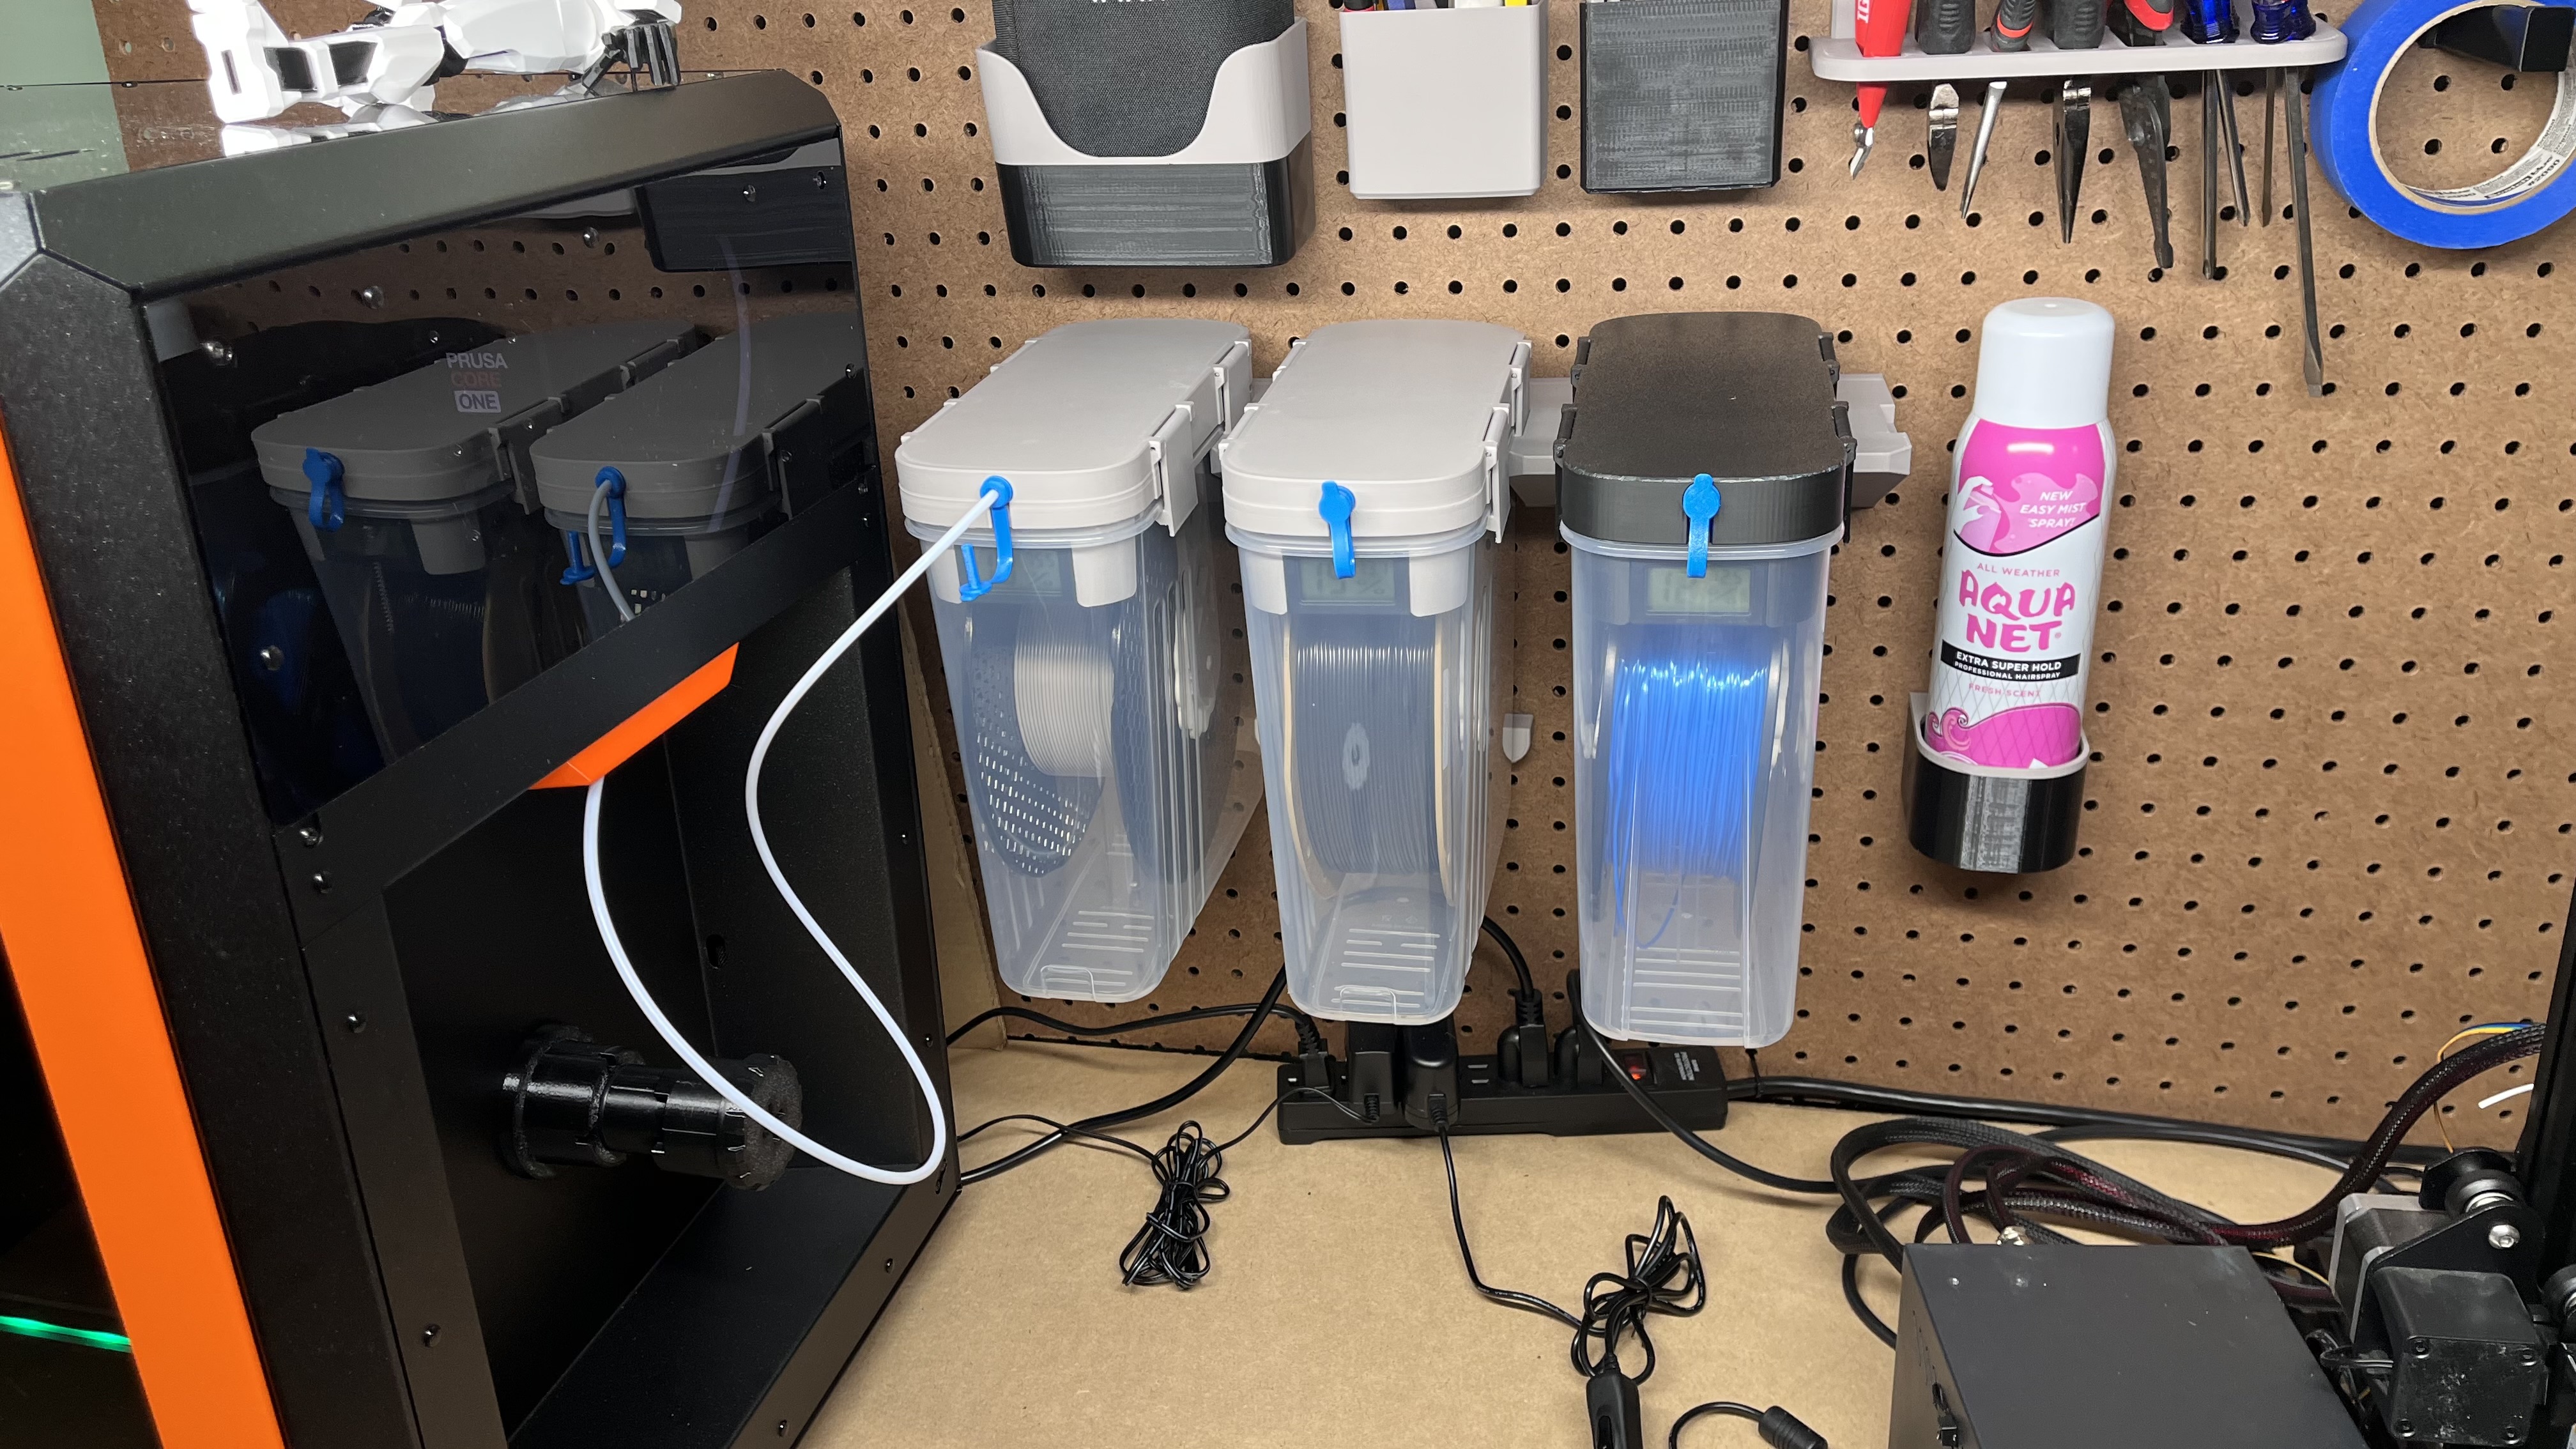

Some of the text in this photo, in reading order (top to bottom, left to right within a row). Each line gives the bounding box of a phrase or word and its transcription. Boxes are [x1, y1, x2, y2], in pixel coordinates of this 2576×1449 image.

[445, 352, 509, 369] PRUSA
[450, 371, 502, 388] CORE
[458, 392, 498, 411] ONE
[2039, 491, 2073, 501] NEW
[2020, 502, 2087, 514] EASY MIST
[2028, 518, 2076, 528] SPRAY!
[1977, 562, 2060, 577] ALL WEATHER
[1959, 569, 2076, 621] AQUA
[1966, 613, 2062, 652] NET
[1956, 651, 2062, 671] EXTRA SUPER HOLD
[1954, 661, 2060, 680] PROFESSIONAL HAIRSPRAY
[1968, 683, 2041, 698] FRESH SCENT
